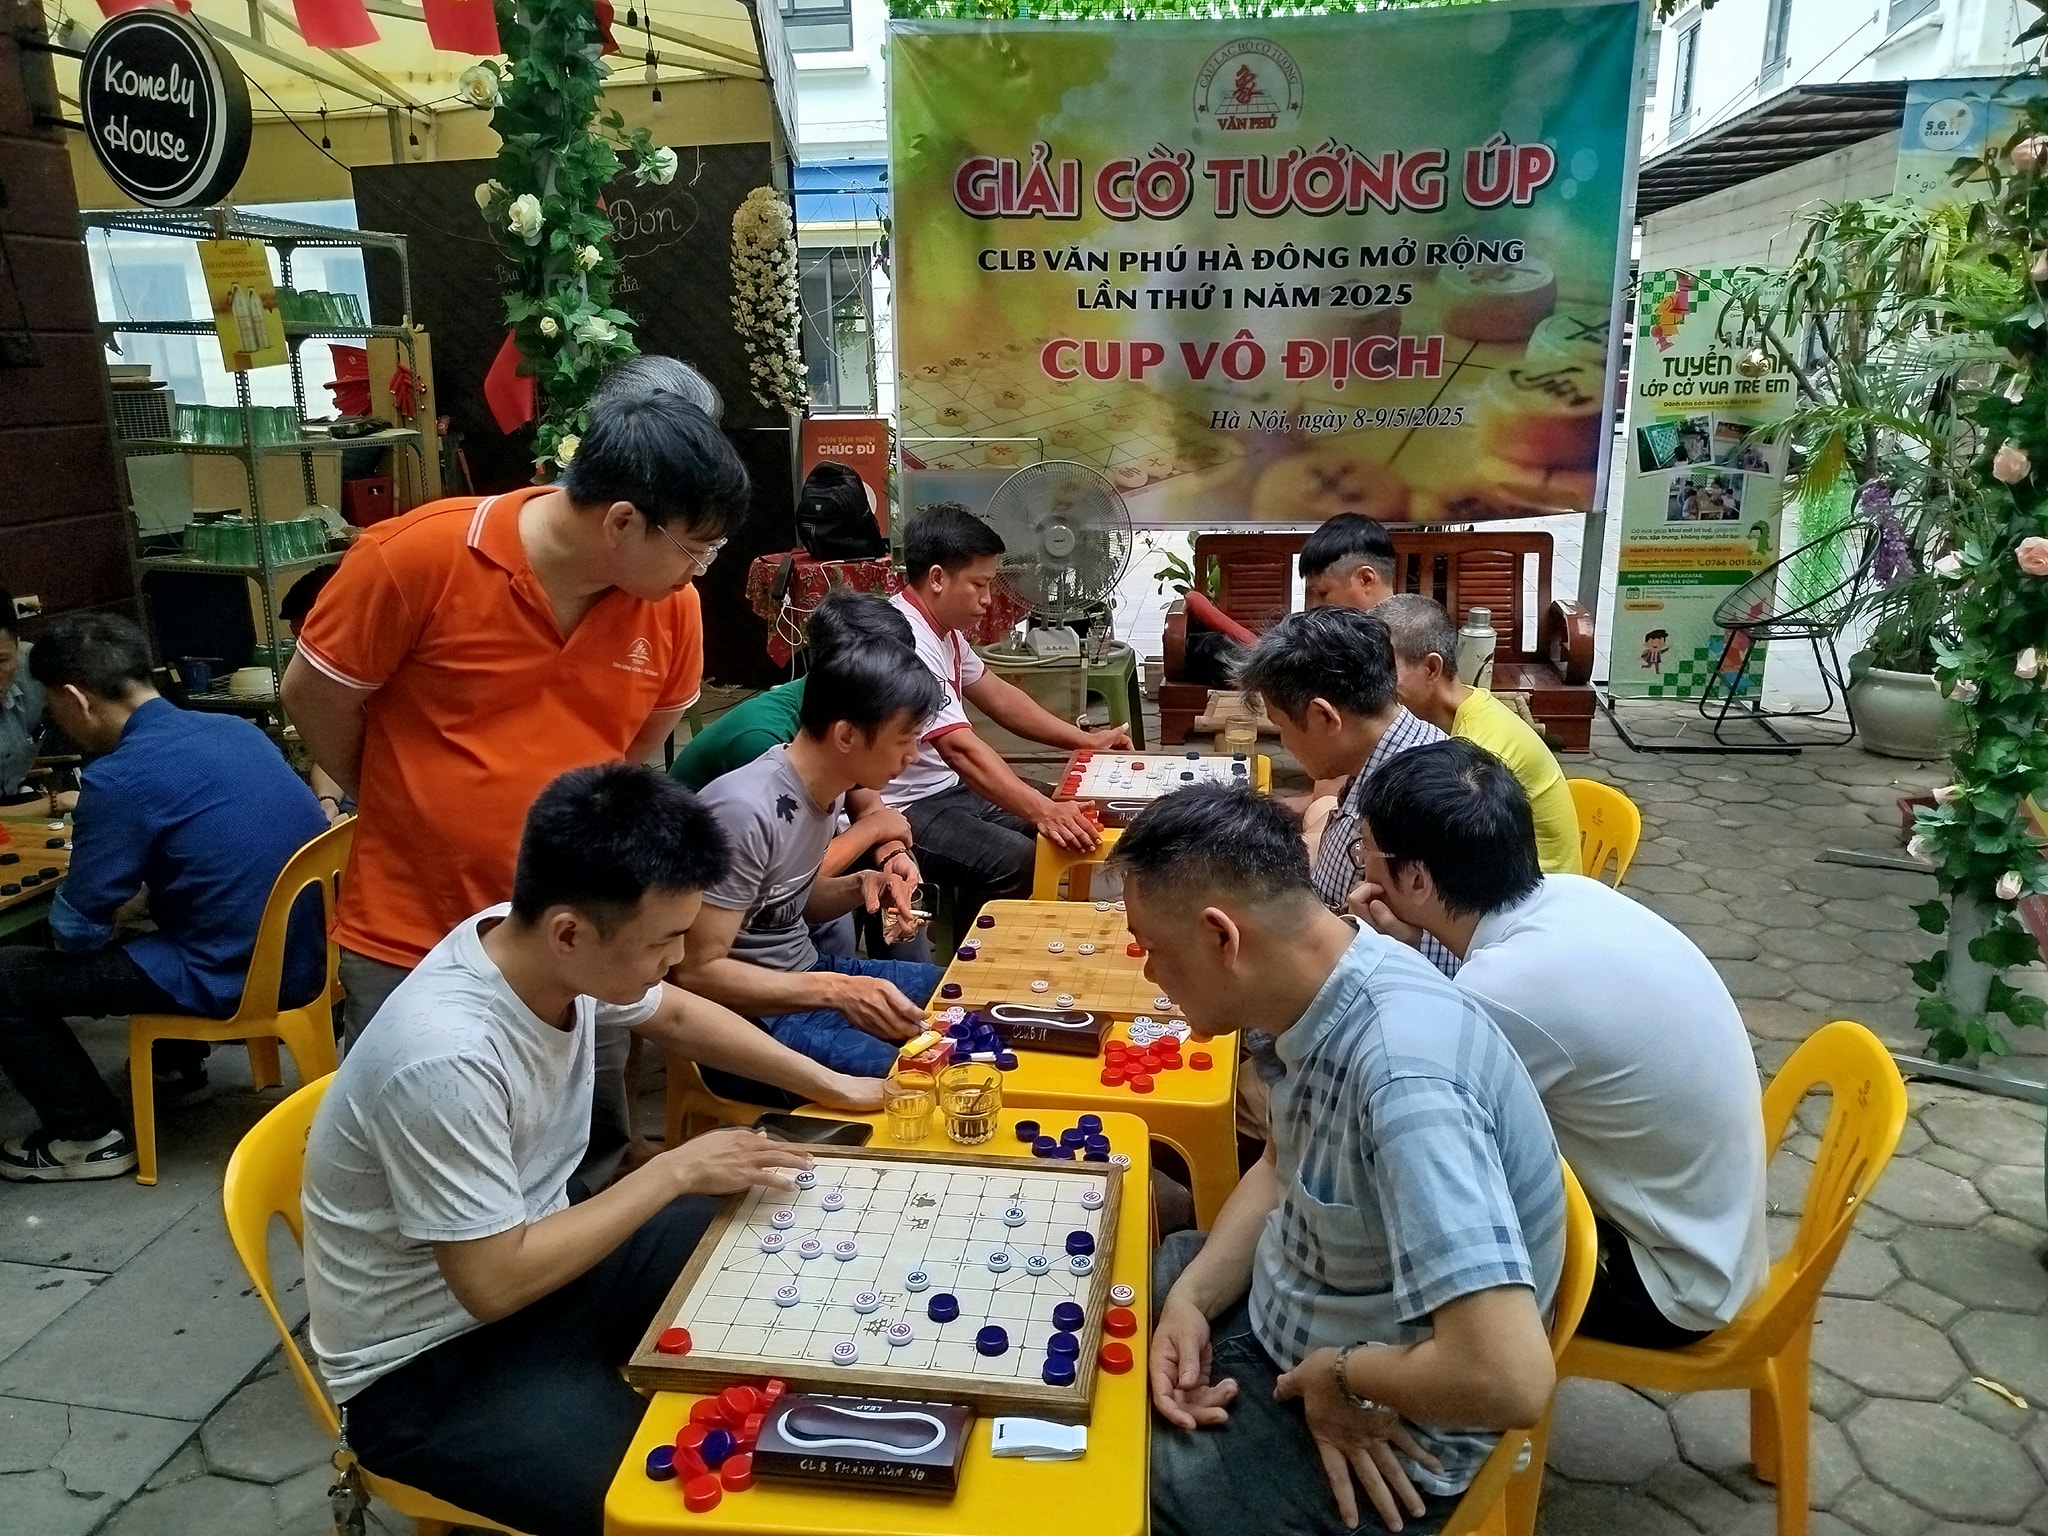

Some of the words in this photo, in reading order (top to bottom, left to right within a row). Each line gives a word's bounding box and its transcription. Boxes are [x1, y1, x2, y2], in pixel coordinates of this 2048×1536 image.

[105, 55, 195, 118] Komely
[1217, 116, 1248, 130] VĂN
[1249, 114, 1278, 130] PHÚ
[104, 114, 190, 162] House
[953, 139, 1082, 220] GIẢI
[1094, 141, 1194, 221] CỜ
[1203, 136, 1449, 218] TƯỚNG
[1462, 131, 1556, 210] ÚP
[977, 249, 1036, 272] CLB
[1043, 244, 1109, 272] VĂN
[1118, 244, 1187, 272] PHÚ
[1198, 243, 1244, 272] HÀ
[1250, 242, 1350, 271] ĐÔNG
[1360, 236, 1418, 268] MỞ
[1425, 234, 1525, 270] RỘNG
[1077, 279, 1138, 310] LẦN
[1146, 282, 1216, 310] THỨ
[1222, 288, 1233, 309] 1
[1244, 282, 1321, 308] NĂM
[1329, 282, 1413, 307] 2025
[1041, 338, 1165, 382] CUP
[1179, 328, 1268, 382] VÔ
[1280, 334, 1445, 391] ĐỊCH
[1662, 345, 1732, 378] TUYỂN
[1640, 378, 1668, 397] LỚP
[1673, 378, 1695, 396] CỜ
[1700, 380, 1728, 395] VUA
[1766, 378, 1790, 393] EM
[1209, 410, 1240, 431] Hà
[1244, 409, 1290, 432] Nội,
[1298, 411, 1348, 434] ngày
[1352, 406, 1466, 429] 8-9/5/2025
[818, 443, 854, 455] CHÚC
[856, 1404, 883, 1412] LEAP
[800, 1458, 827, 1473] CLB
